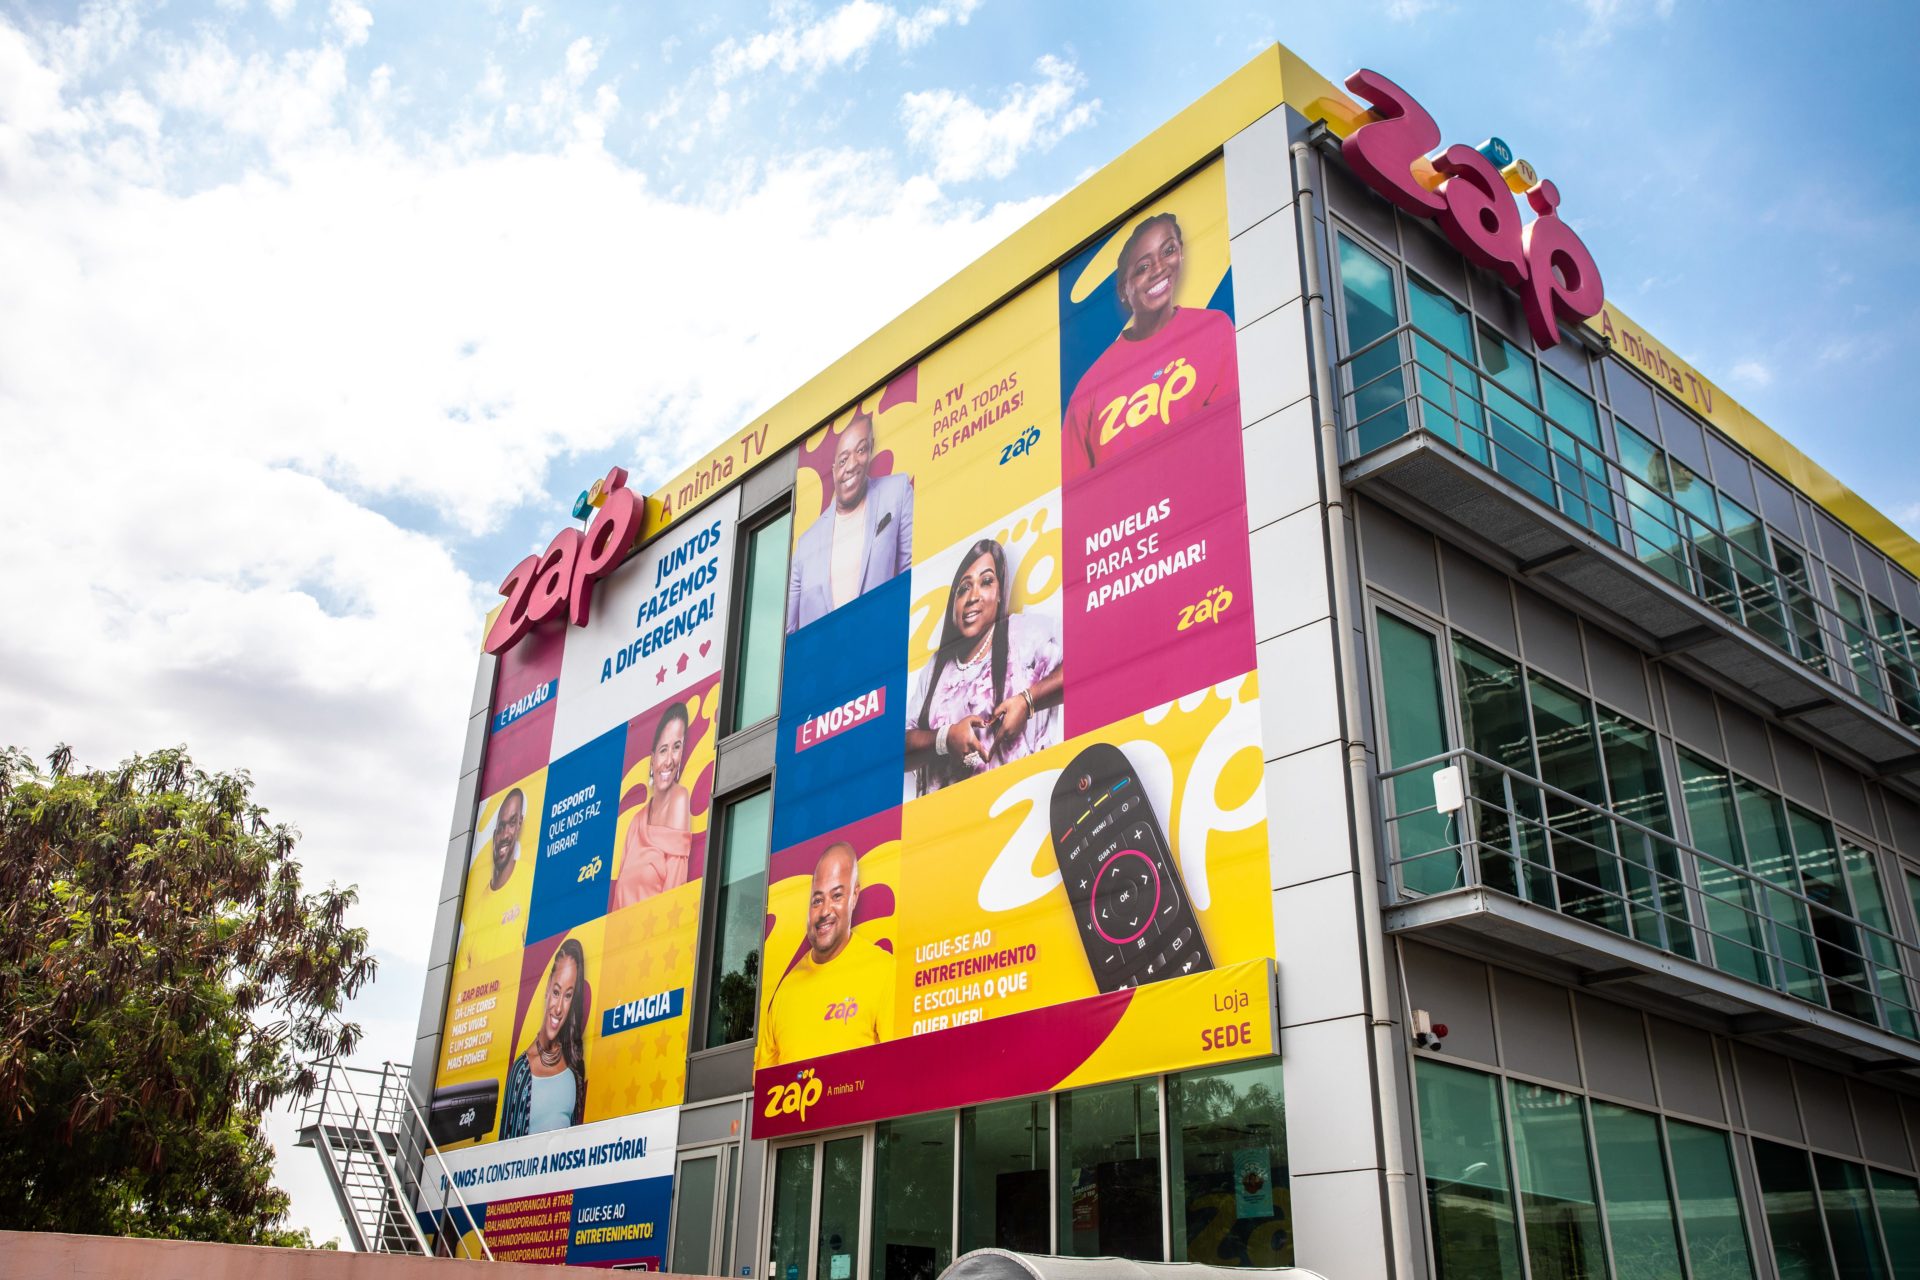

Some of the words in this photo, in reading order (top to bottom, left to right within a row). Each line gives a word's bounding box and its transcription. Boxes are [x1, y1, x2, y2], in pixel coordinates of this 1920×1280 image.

[1494, 142, 1509, 162] HD
[1520, 159, 1533, 180] TV
[1342, 68, 1604, 351] zap
[1602, 309, 1617, 343] A
[1621, 329, 1684, 393] minha
[1685, 371, 1712, 413] TV
[933, 399, 942, 416] A
[945, 383, 964, 406] TV
[933, 404, 968, 438] PARA
[971, 371, 1017, 412] TODAS
[1098, 357, 1197, 446] zap
[931, 437, 949, 461] AS
[952, 390, 1024, 448] FAMÍLIAS!
[999, 425, 1041, 466] zap
[659, 493, 673, 523] A
[677, 455, 734, 510] minha
[740, 423, 769, 464] TV
[1085, 498, 1171, 556] NOVELAS
[484, 466, 644, 655] zap
[655, 519, 722, 589] JUNTOS
[1086, 546, 1133, 584] PARA
[1136, 532, 1159, 560] SE
[636, 556, 718, 628] FAZEMOS
[1085, 539, 1206, 613] APAIXONAR!
[1176, 584, 1233, 631] zap
[600, 657, 612, 684] A
[615, 592, 715, 676] DIFERENÇA!
[500, 704, 509, 726] É
[508, 682, 549, 723] PAIXÃO
[802, 714, 813, 744] É
[816, 689, 879, 739] NOSSA
[551, 784, 596, 818] DESPORTO
[548, 820, 566, 840] QUE
[566, 811, 583, 831] NOS
[584, 800, 602, 821] FAZ
[1092, 821, 1107, 837] MENU
[546, 831, 579, 859] VIBRAR!
[1070, 846, 1081, 860] EXIT
[1109, 843, 1117, 852] TV
[577, 855, 603, 883] zap
[1119, 891, 1130, 902] OK
[915, 933, 971, 964] LIGUE-SE
[972, 929, 991, 949] AO
[914, 943, 1036, 988] ENTRETENIMENTO
[462, 988, 475, 1002] ZAP
[475, 983, 489, 998] BOX
[490, 980, 499, 993] HD
[476, 996, 497, 1013] CORES
[913, 995, 922, 1013] E
[924, 982, 981, 1011] ESCOLHA
[983, 979, 994, 997] O
[997, 971, 1028, 998] QUE
[1213, 989, 1249, 1014] Loja
[452, 1022, 468, 1037] MAIS
[468, 1015, 488, 1033] VIVAS
[612, 999, 622, 1029] É
[623, 990, 671, 1026] MAGIA
[824, 997, 858, 1025] zap
[912, 1015, 949, 1036] QUER
[952, 1007, 983, 1027] VER!
[453, 1039, 464, 1053] UM
[464, 1034, 479, 1049] SOM
[478, 1031, 493, 1047] COM
[1201, 1021, 1251, 1052] SEDE
[446, 1056, 462, 1071] MAIS
[462, 1048, 488, 1066] POWER!
[764, 1067, 823, 1122] zap
[827, 1086, 833, 1097] A
[833, 1082, 854, 1096] minha
[855, 1079, 865, 1092] TV
[459, 1107, 476, 1128] zap
[477, 1166, 484, 1185] A
[486, 1156, 539, 1184] CONSTRUIR
[540, 1155, 548, 1174] A
[550, 1148, 586, 1173] NOSSA
[588, 1136, 647, 1166] HISTÓRIA!
[577, 1204, 613, 1224] LIGUE-SE
[613, 1203, 625, 1219] AO
[575, 1221, 654, 1246] ENTRETENIMENTO!
